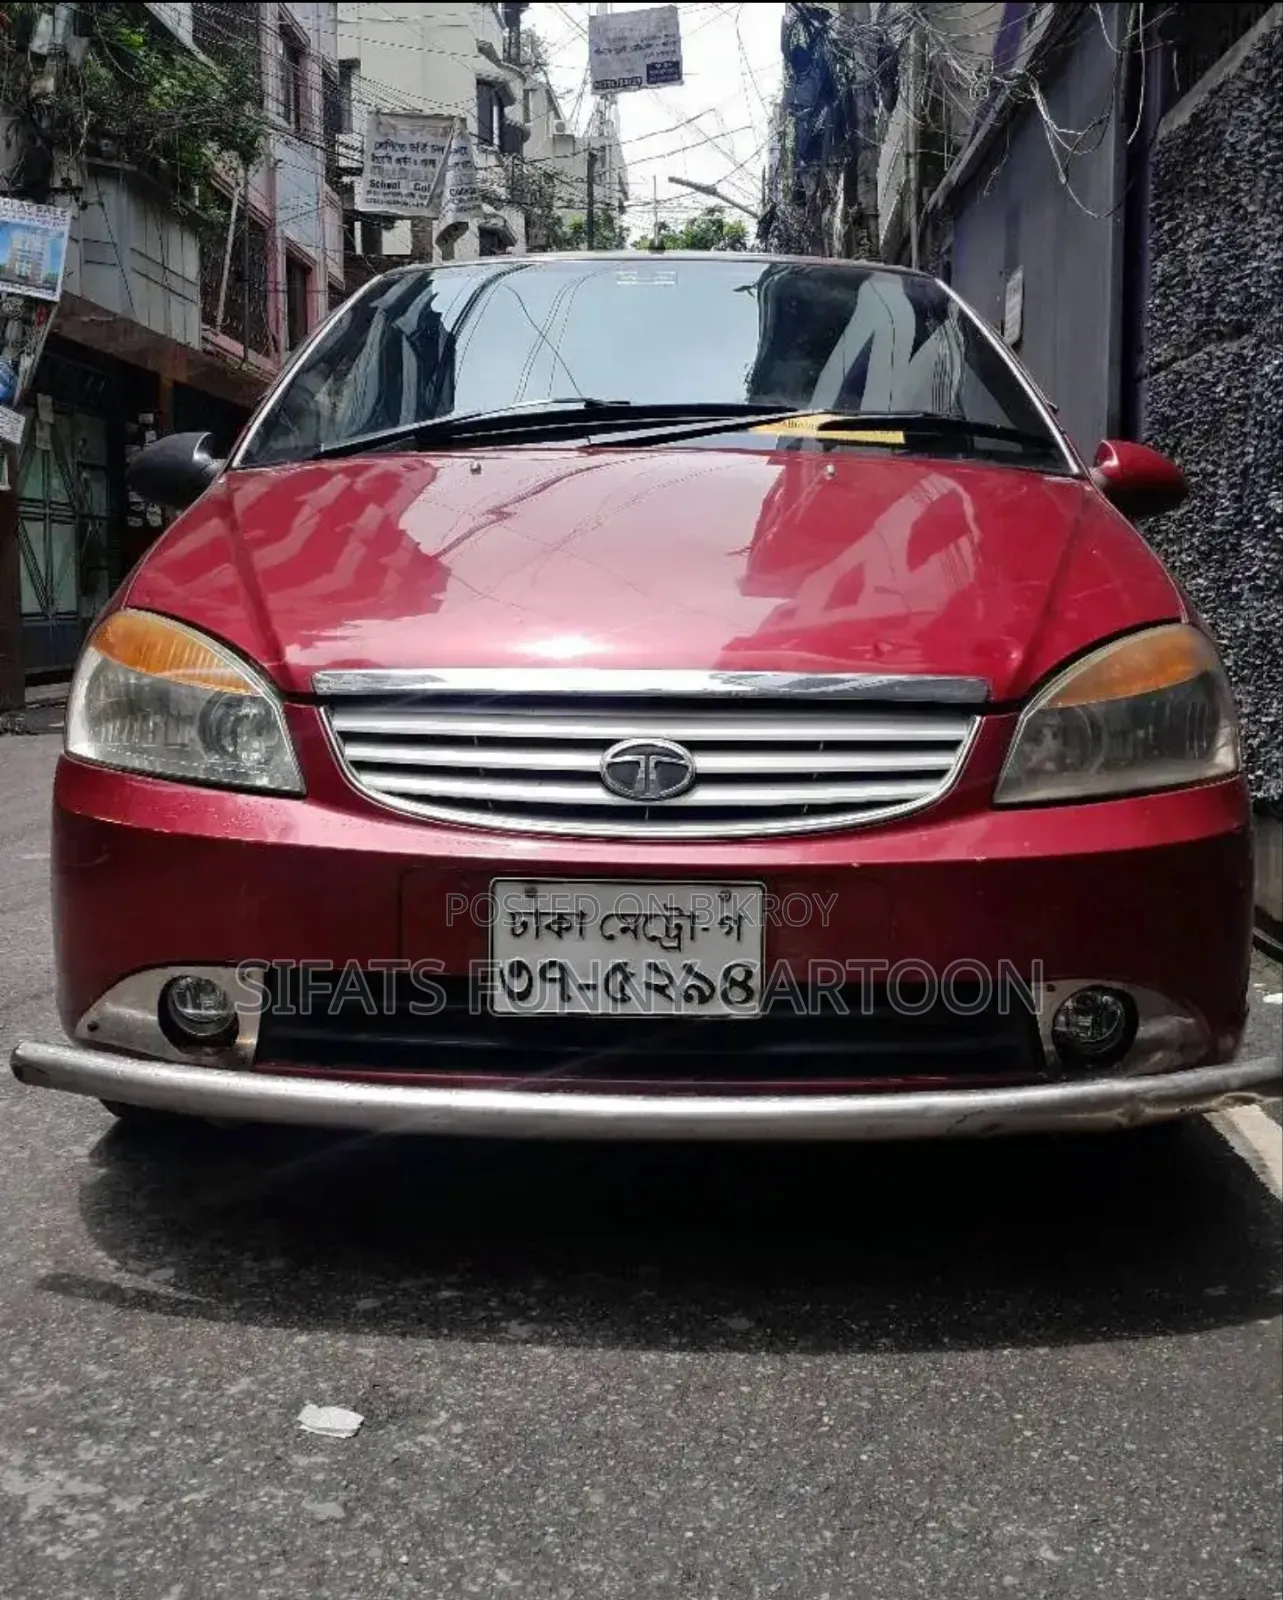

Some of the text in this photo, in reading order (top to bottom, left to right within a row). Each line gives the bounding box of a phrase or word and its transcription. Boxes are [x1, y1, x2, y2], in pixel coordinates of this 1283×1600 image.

[369, 179, 400, 190] School
[36, 204, 68, 218] SALE
[507, 906, 588, 941] ঢাকা
[499, 959, 757, 1005] ৩৭-৫২৯৪
